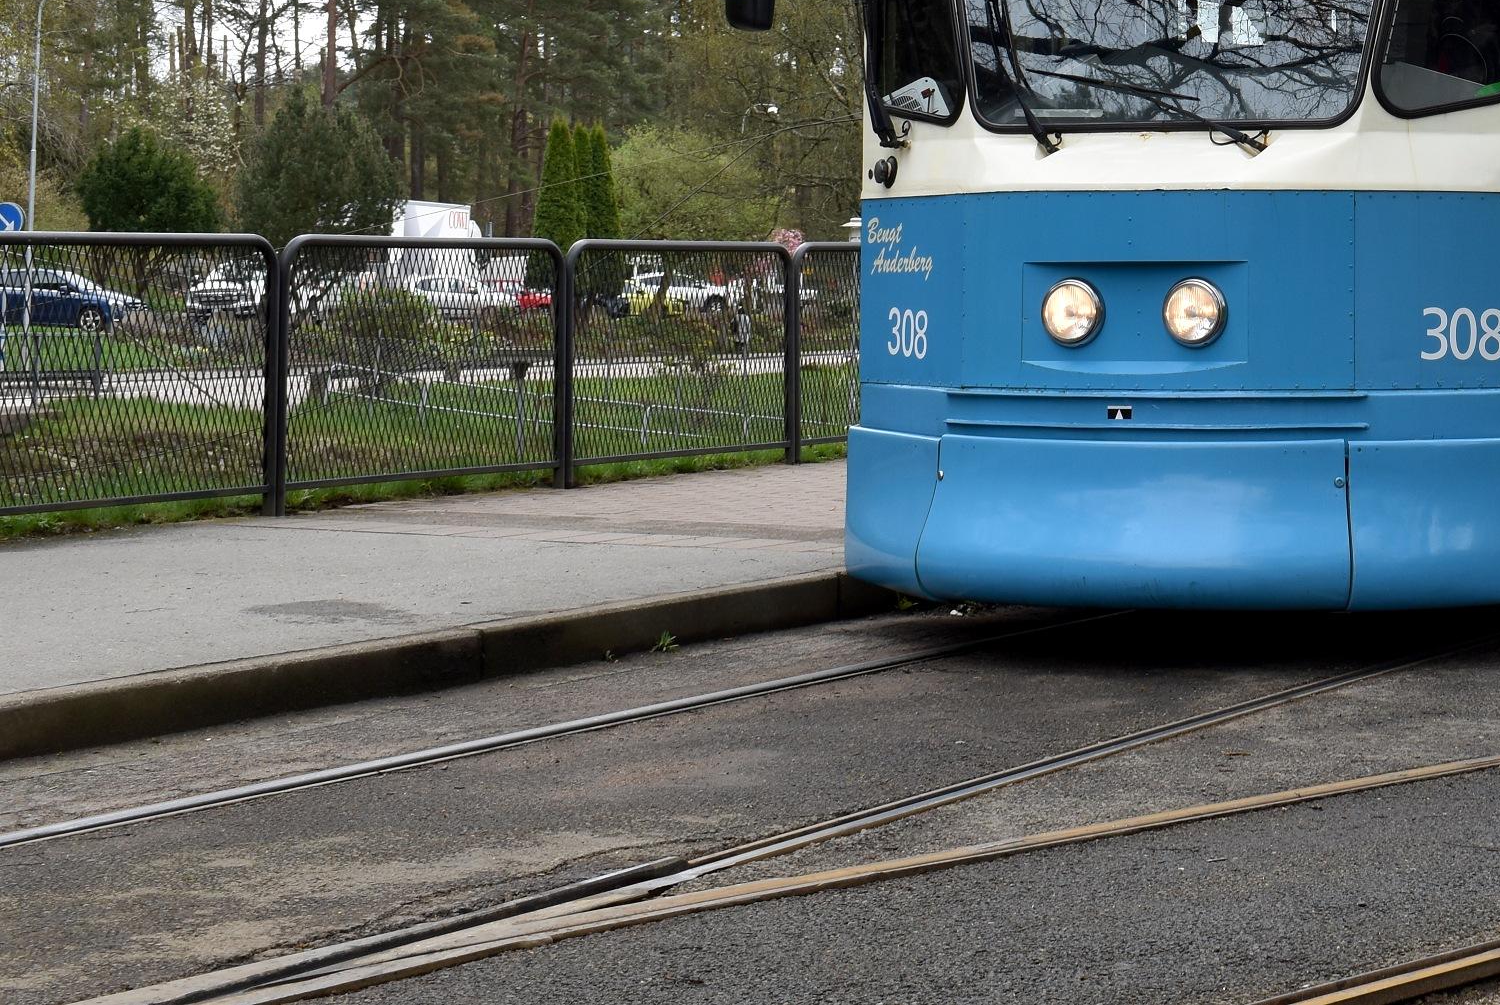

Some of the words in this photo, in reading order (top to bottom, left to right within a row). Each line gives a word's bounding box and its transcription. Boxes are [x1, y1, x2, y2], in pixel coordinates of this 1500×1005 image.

[867, 217, 902, 251] Bengt
[871, 246, 933, 281] Anderberg
[887, 306, 928, 359] 308
